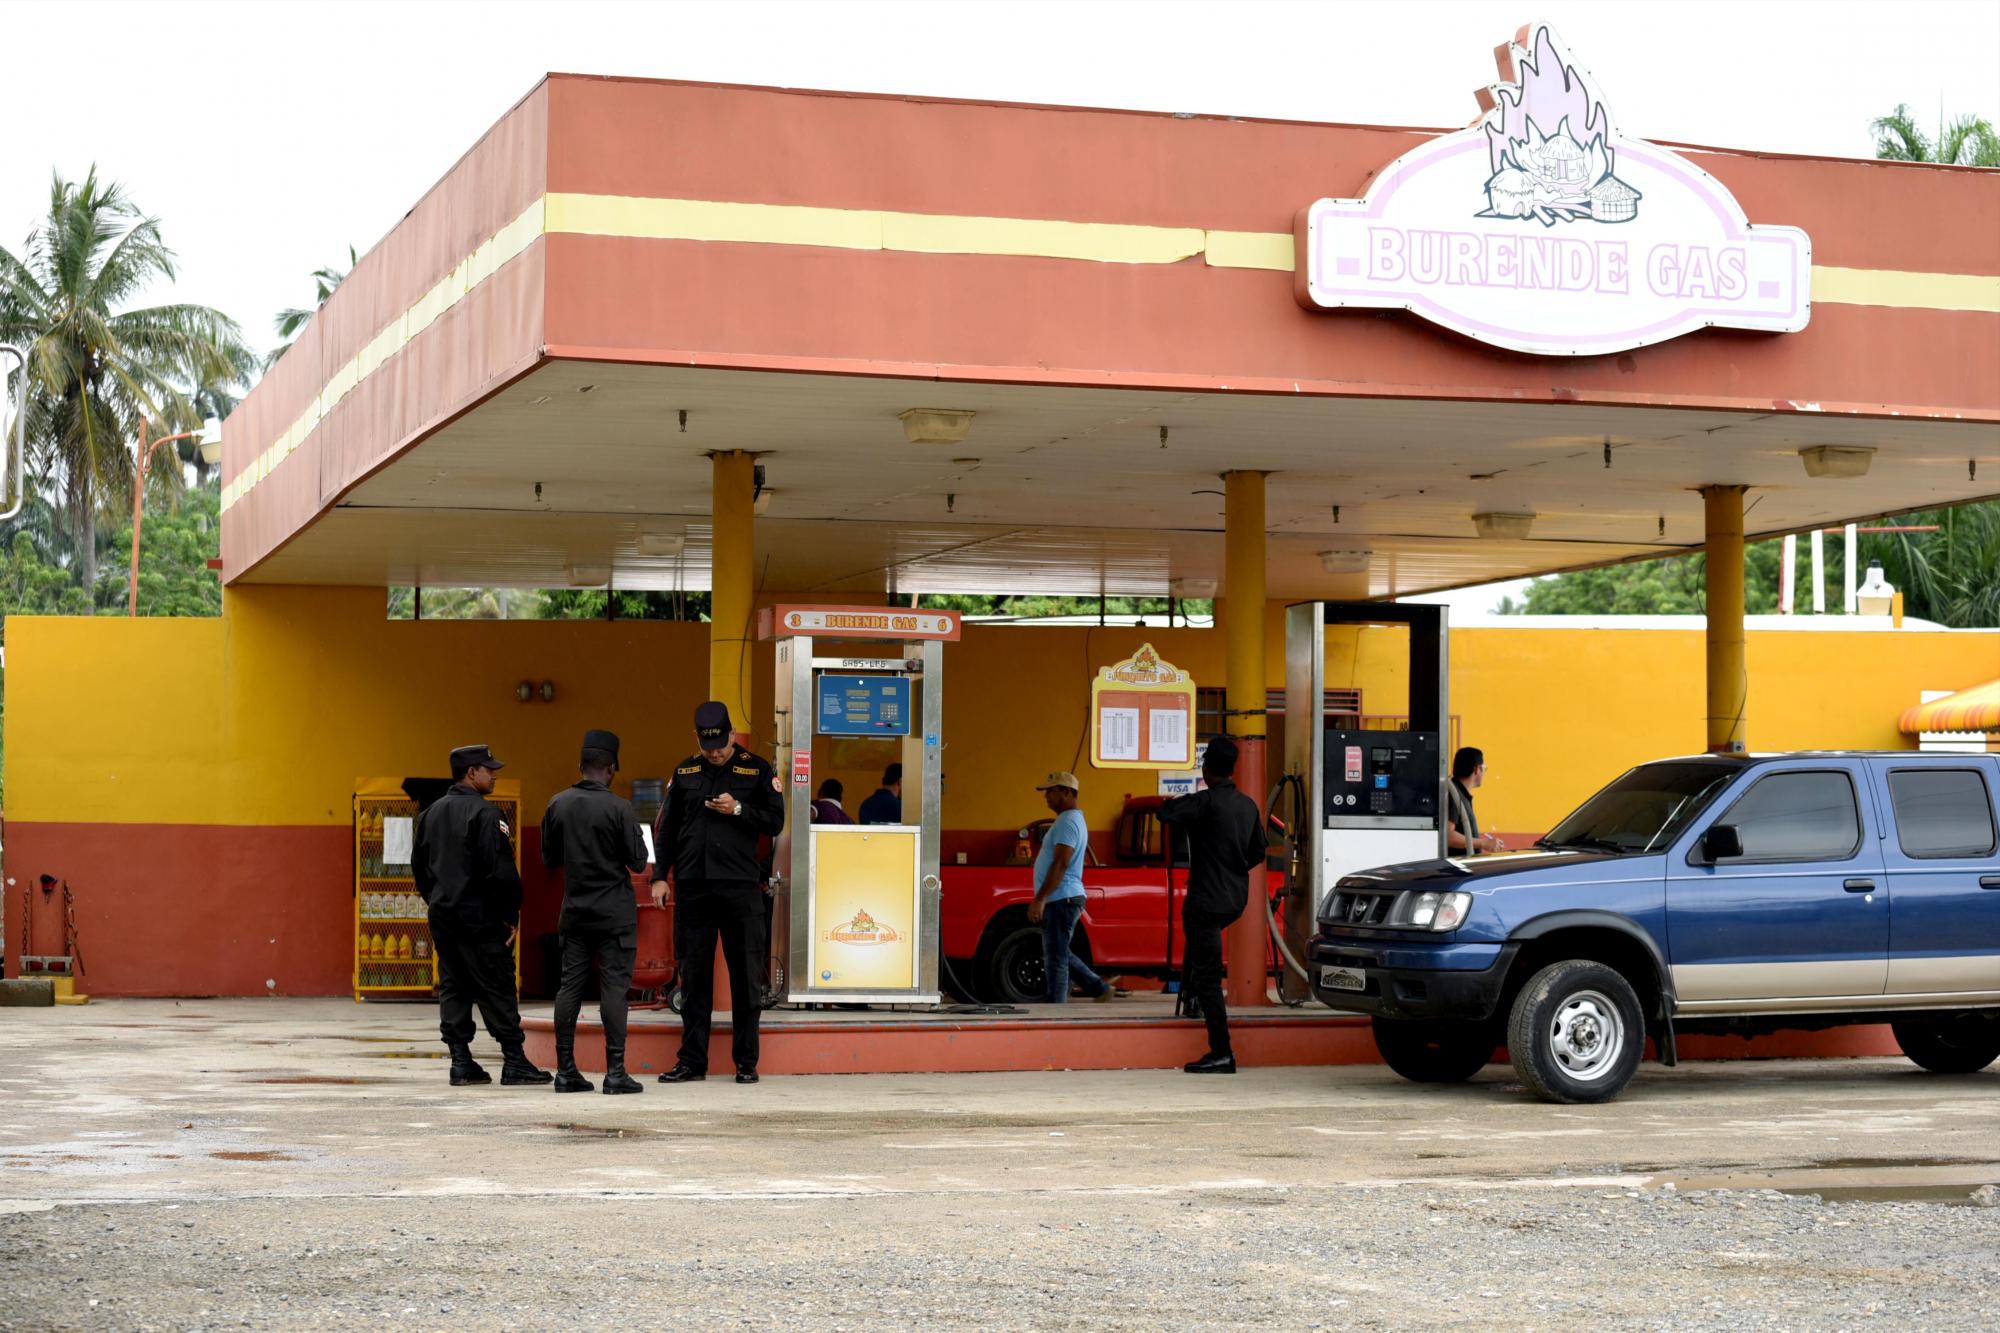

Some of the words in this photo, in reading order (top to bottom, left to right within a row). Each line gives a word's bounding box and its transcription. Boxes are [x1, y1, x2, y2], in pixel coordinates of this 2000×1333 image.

[1367, 227, 1630, 294] BURENDE
[1647, 243, 1748, 300] GAS
[825, 614, 889, 629] BURENDE
[892, 616, 918, 630] GAS
[937, 618, 947, 631] 6
[1167, 784, 1189, 793] VISA
[1322, 977, 1363, 988] NISSAN
